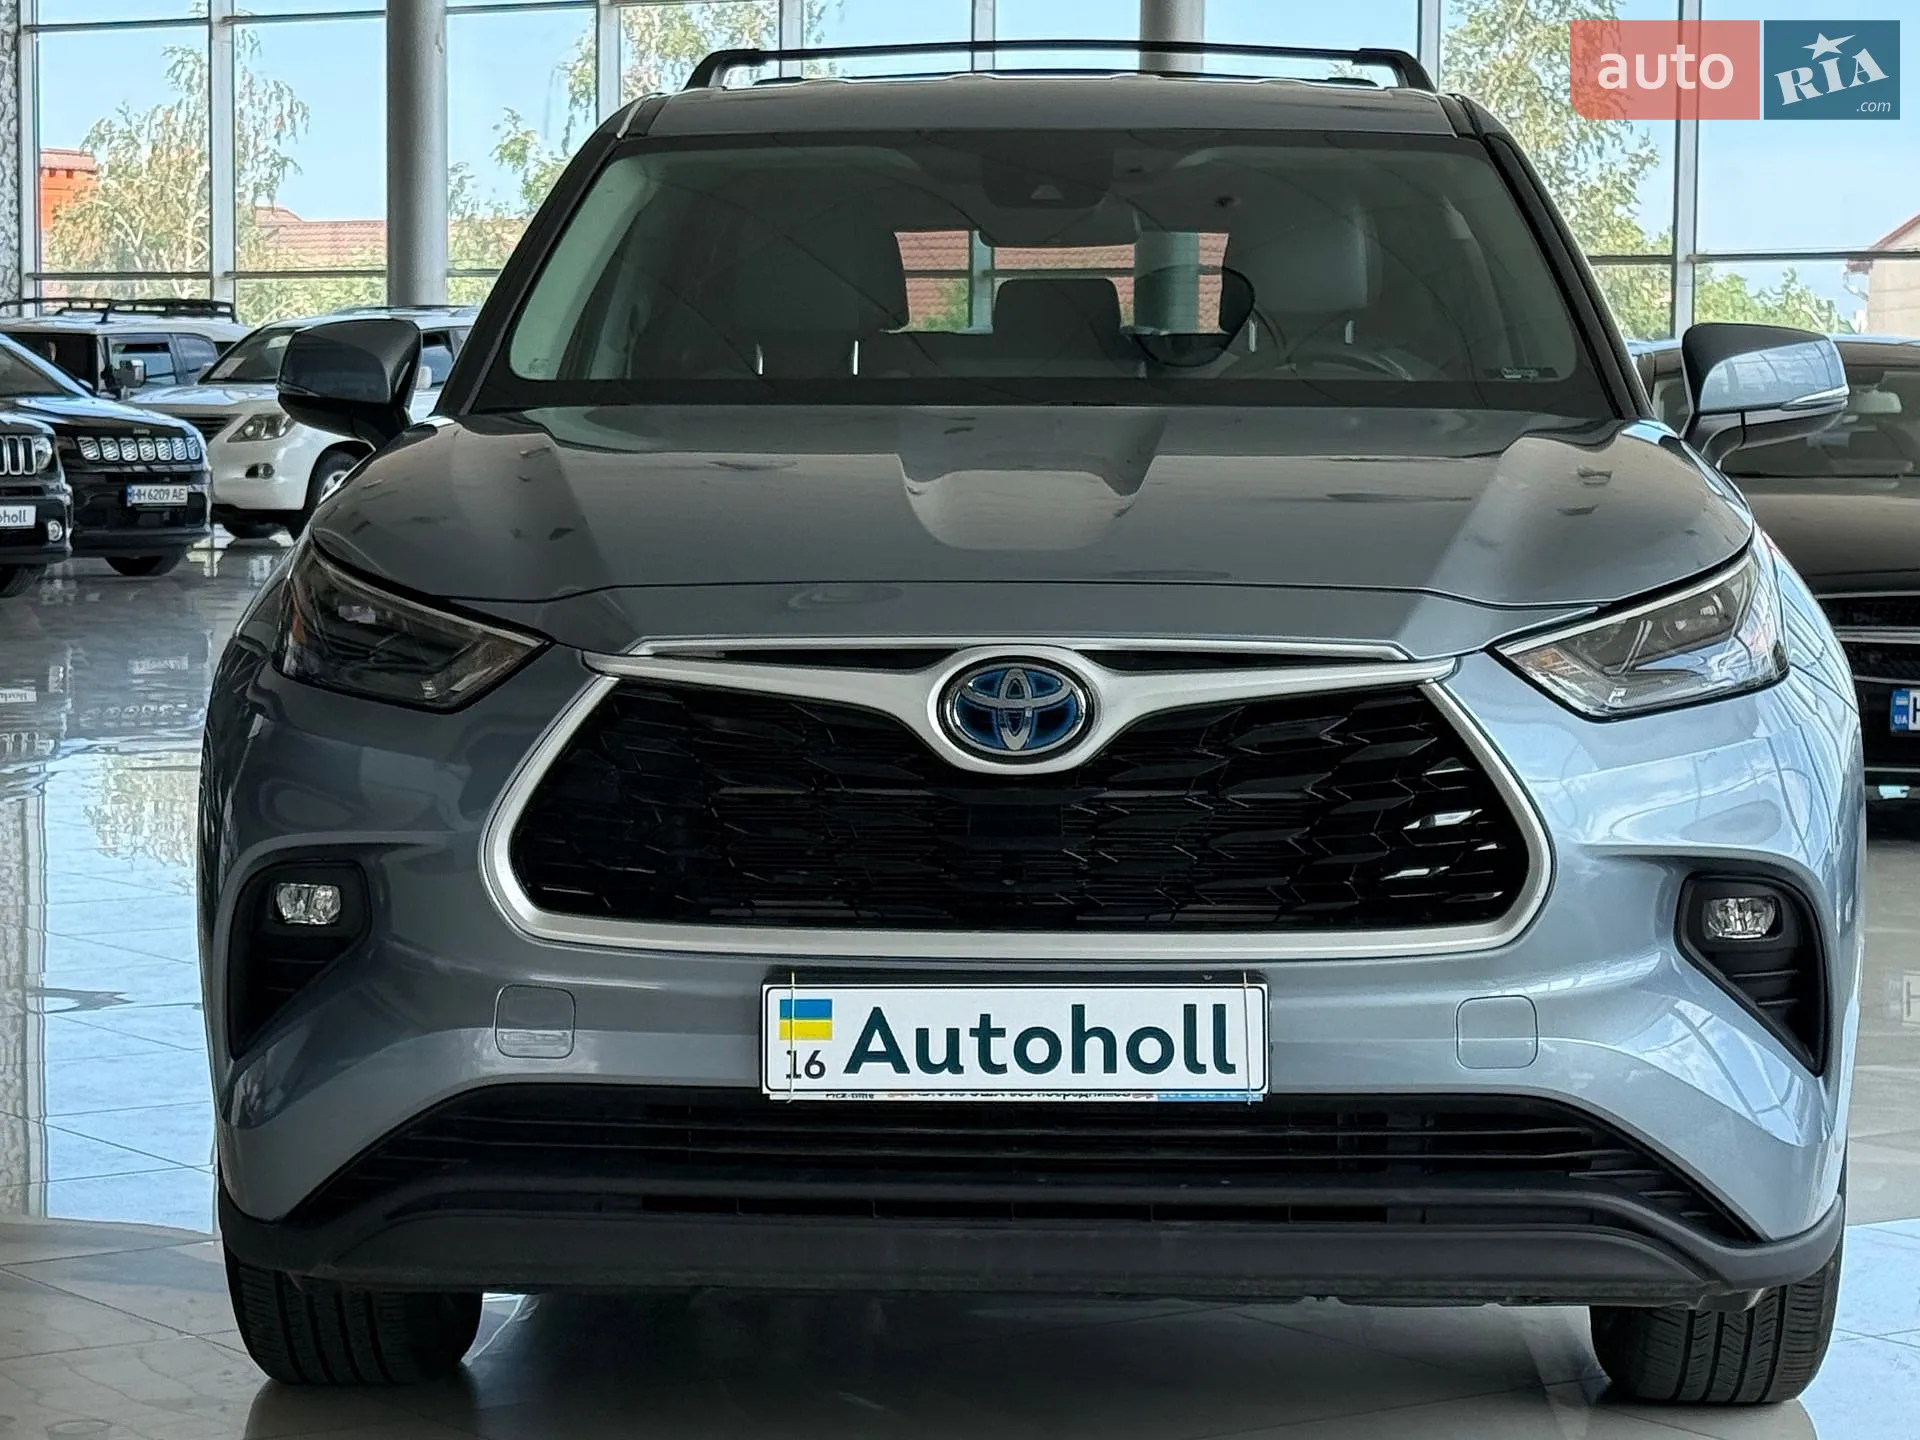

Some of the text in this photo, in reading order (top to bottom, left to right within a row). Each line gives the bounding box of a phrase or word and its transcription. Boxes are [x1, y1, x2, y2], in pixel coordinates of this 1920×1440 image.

[147, 488, 171, 501] 6209
[842, 1003, 1237, 1075] Autoholl
[785, 1049, 826, 1080] 16
